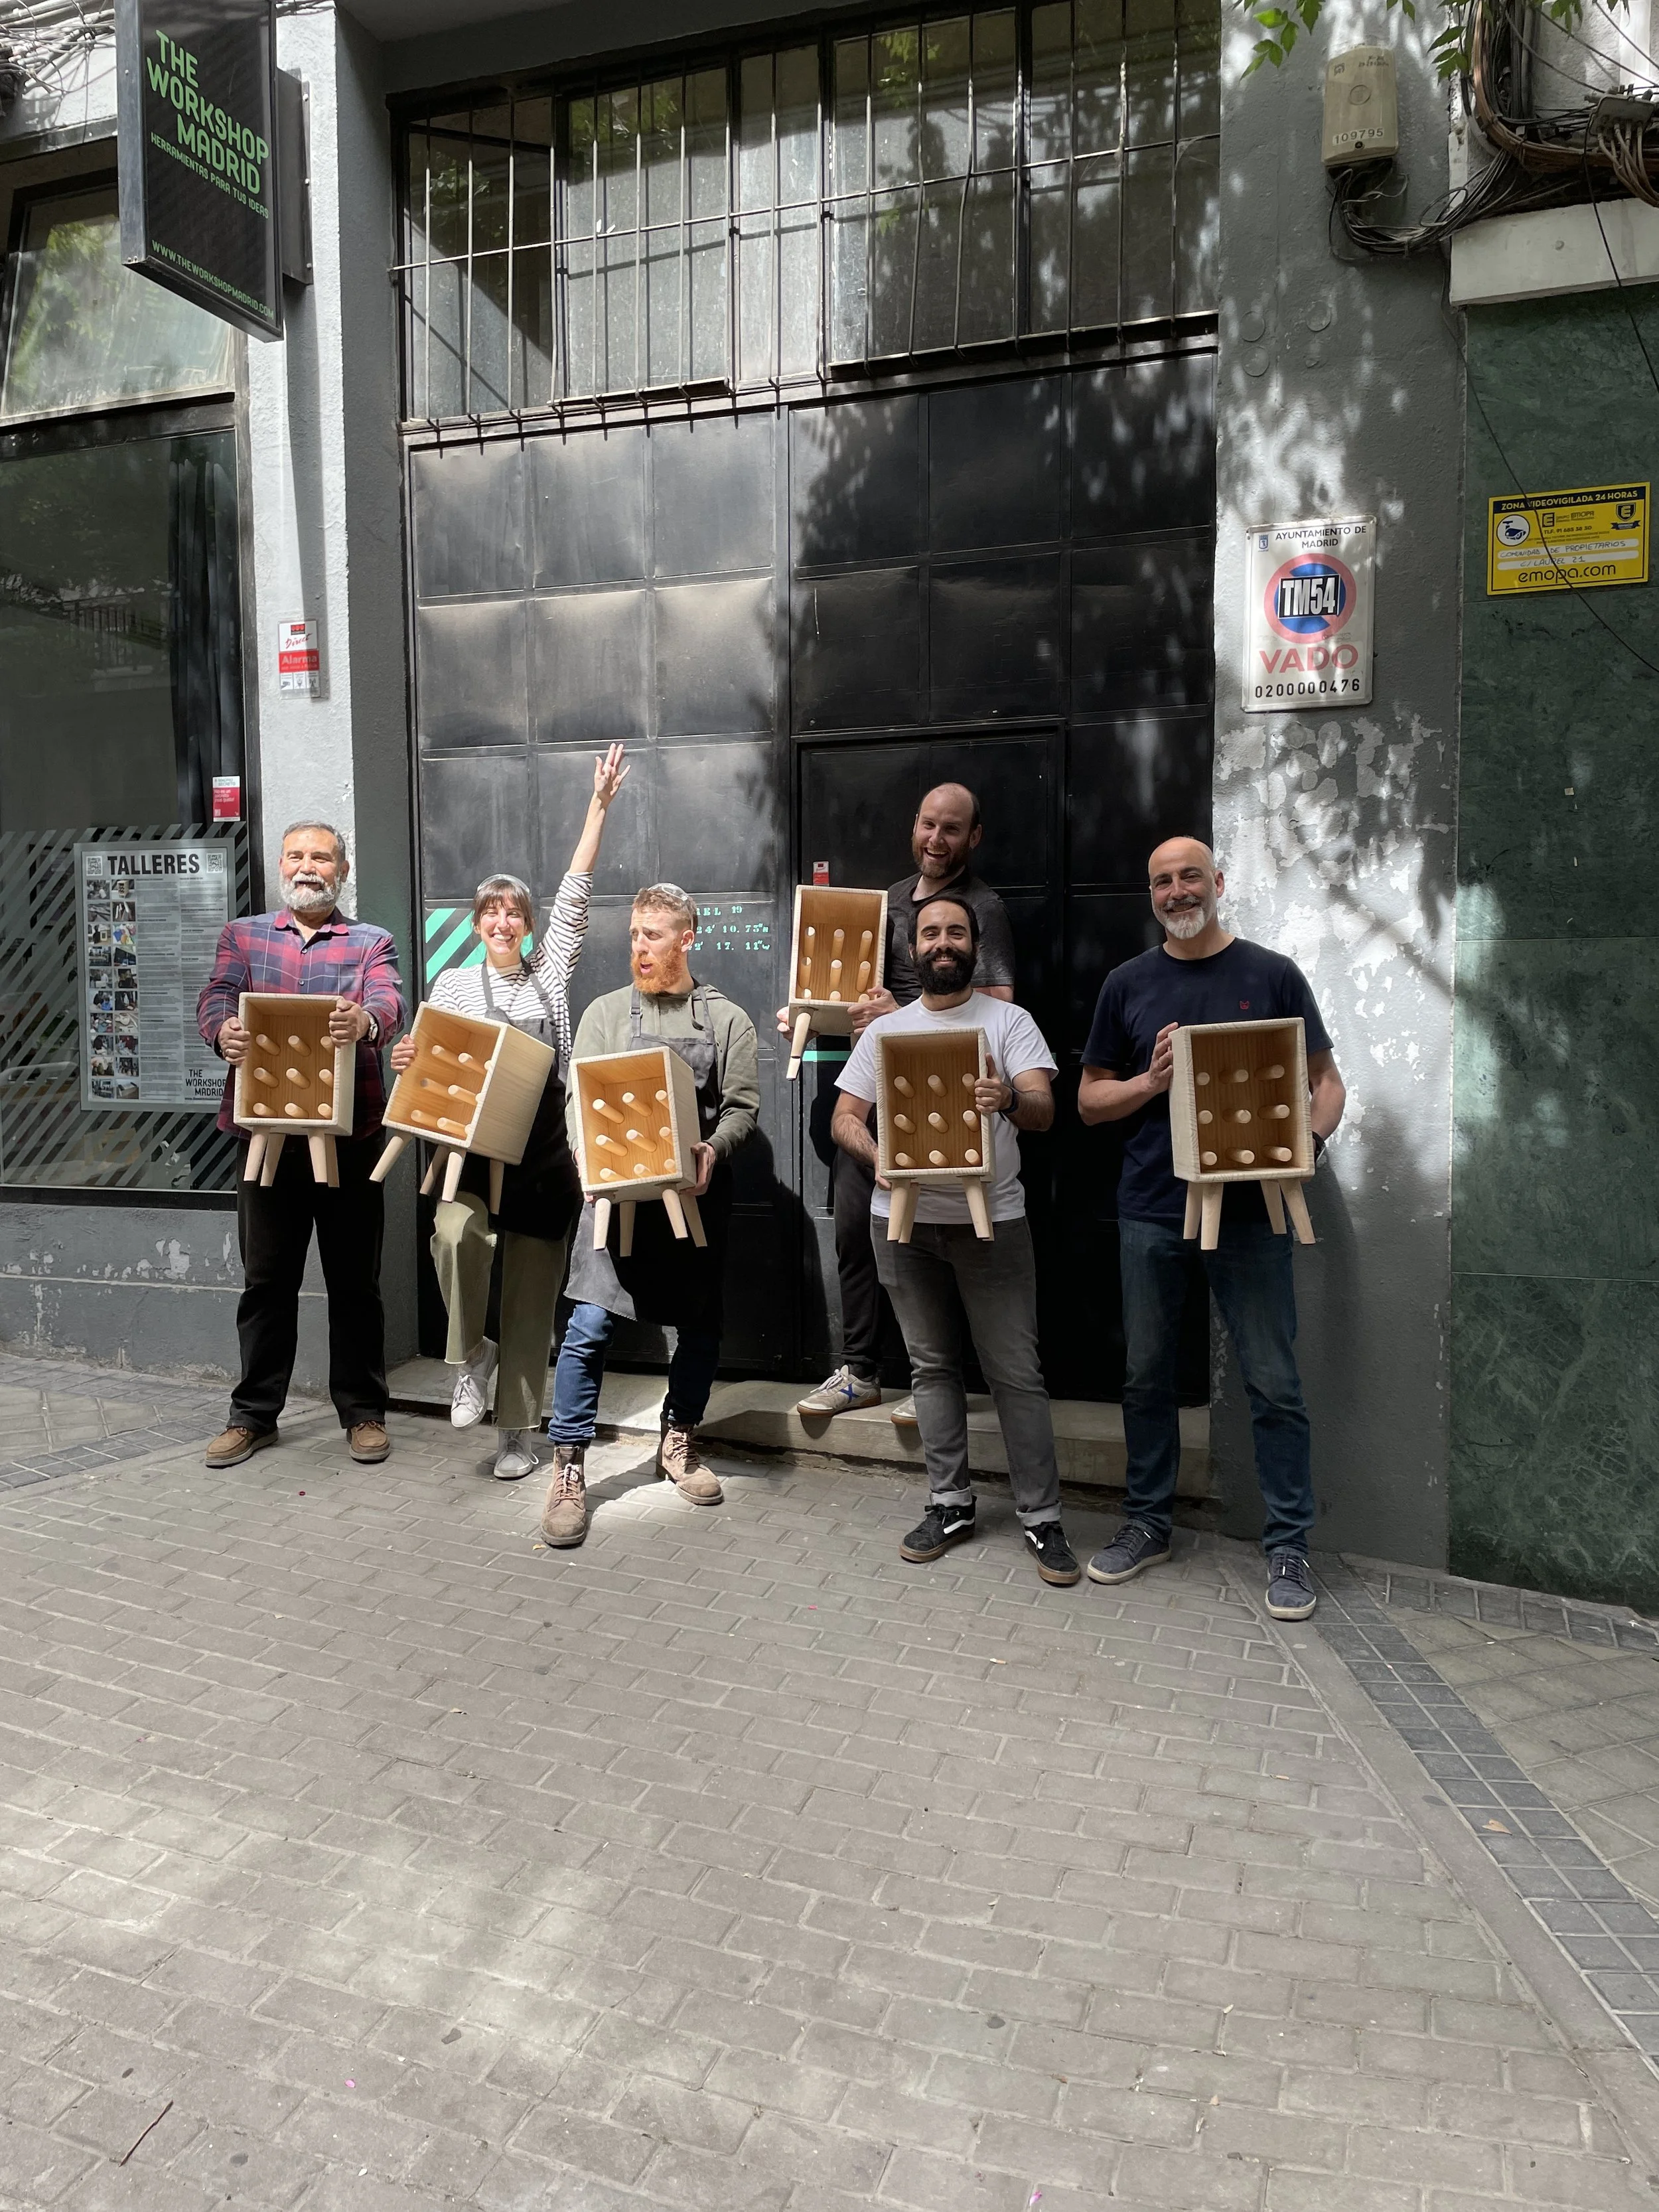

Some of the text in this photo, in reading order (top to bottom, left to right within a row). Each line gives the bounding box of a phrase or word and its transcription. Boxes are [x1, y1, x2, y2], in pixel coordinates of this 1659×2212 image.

[156, 29, 198, 88] THE
[147, 56, 269, 165] WORKSHOP
[1334, 128, 1384, 144] 109795
[177, 113, 260, 194] MADRID
[151, 132, 269, 218] HERRAMIENTAS PARA TUS IDEAS
[152, 239, 274, 319] WWW.THEWORKSHOPMADRID.COM
[1528, 496, 1593, 507] VIDEOVIGILADA
[1275, 527, 1350, 540] AYUNTAMIENTO
[1302, 538, 1338, 549] MADRID
[1500, 549, 1540, 558] COMUNIDAD
[1565, 540, 1626, 552] PROPIETARIOS
[1518, 564, 1616, 583] emopa.com
[1282, 577, 1336, 617] TM54
[281, 654, 318, 664] Alarma
[1259, 644, 1359, 674] VADO
[1255, 678, 1360, 698] 0200000476
[108, 853, 200, 875] TALLERES
[731, 905, 743, 914] 19
[189, 1069, 202, 1078] THE
[194, 1088, 224, 1096] MADRID
